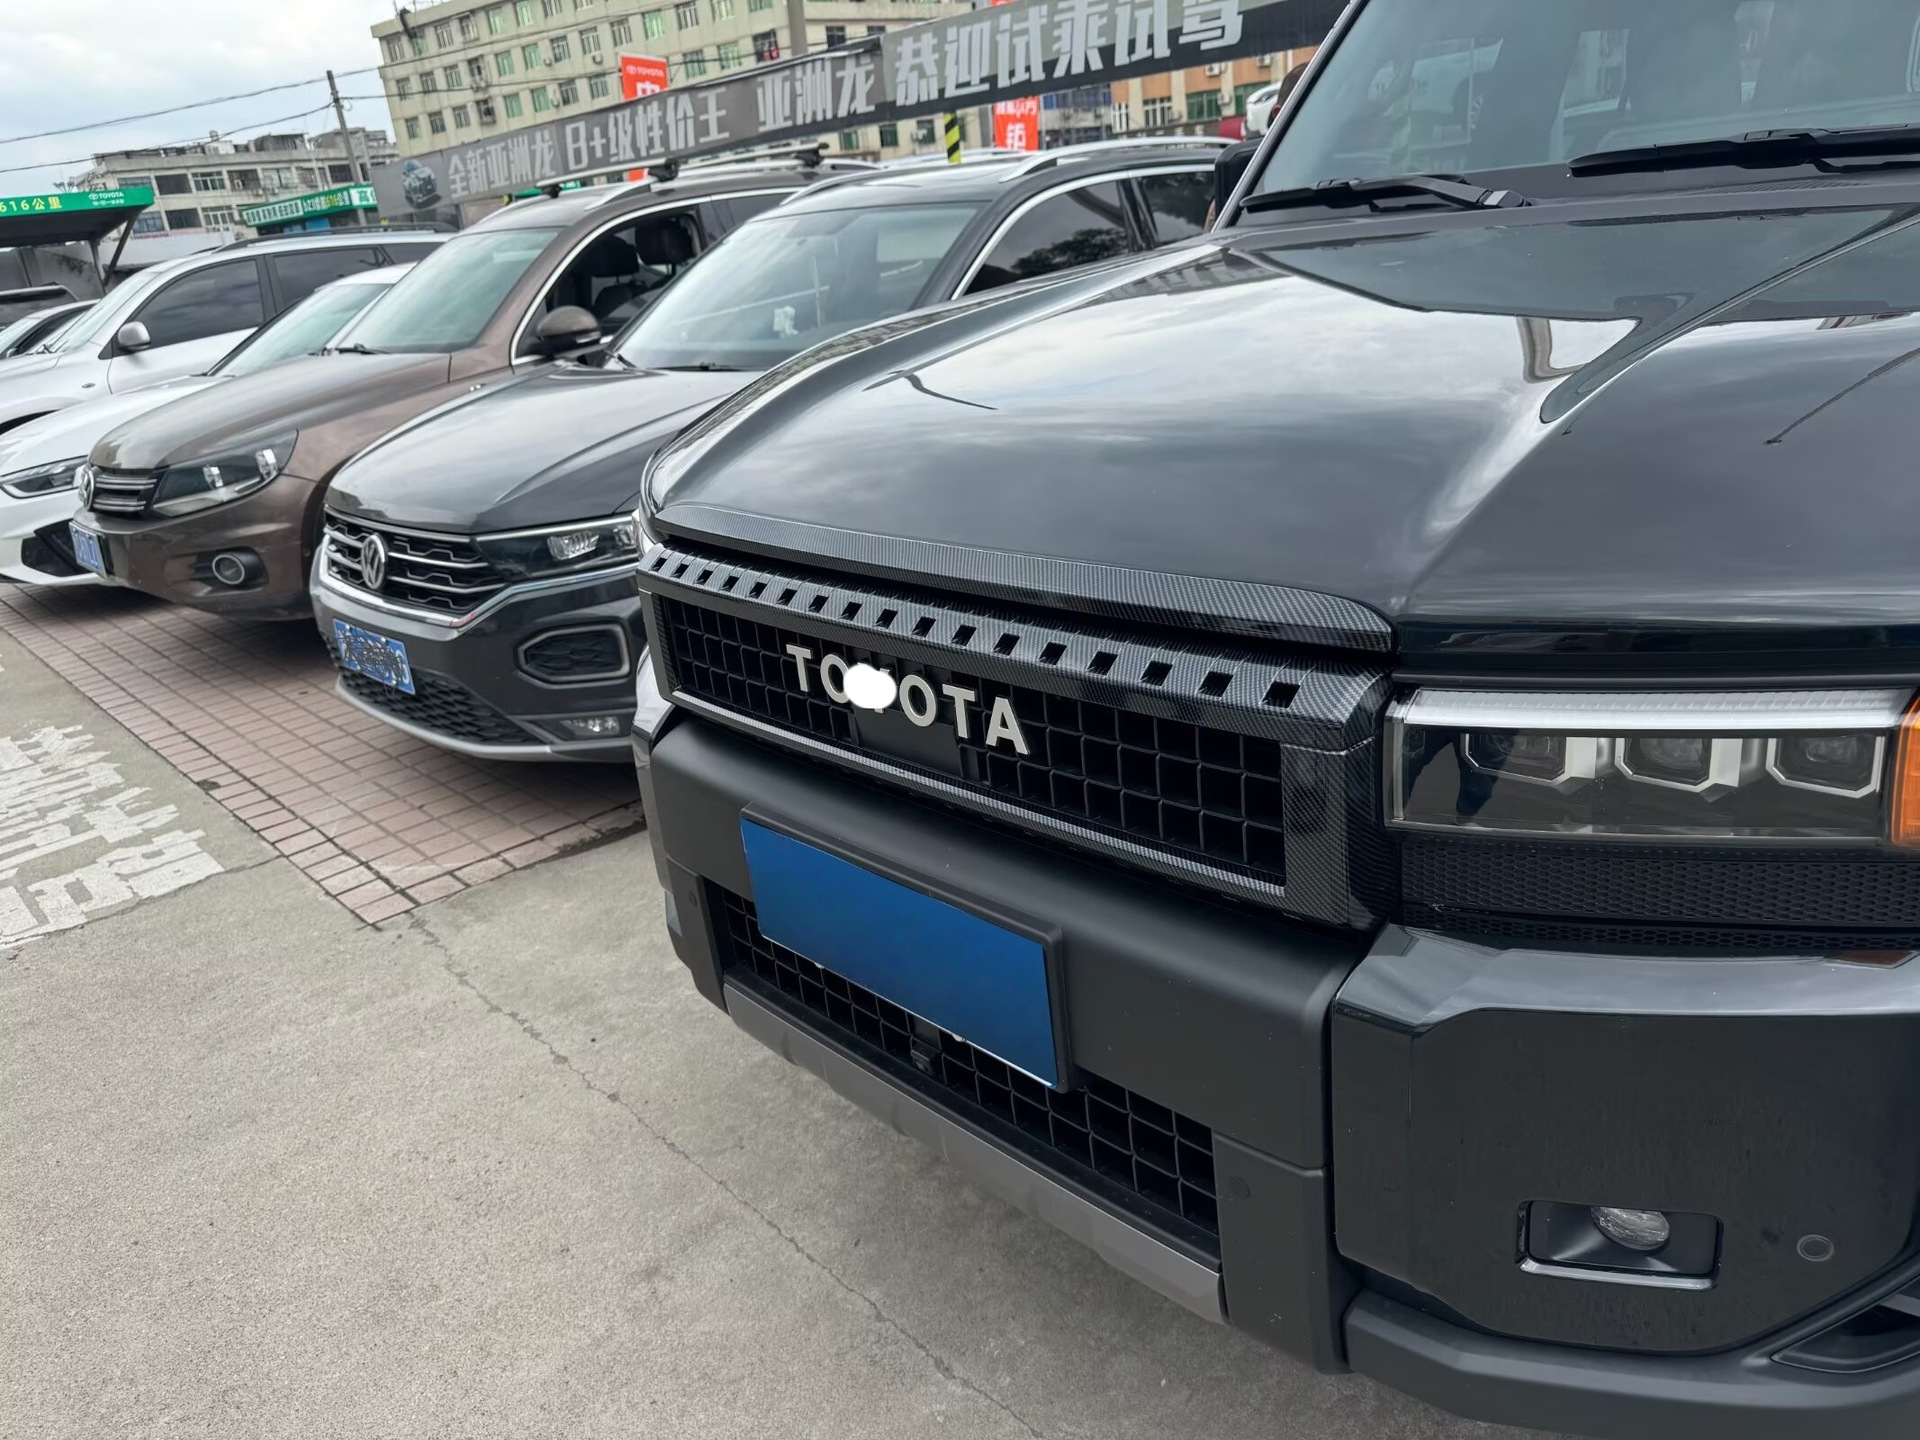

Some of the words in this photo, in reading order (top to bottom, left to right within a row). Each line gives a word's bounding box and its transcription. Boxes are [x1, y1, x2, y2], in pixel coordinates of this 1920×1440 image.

[448, 129, 556, 198] 全新亚洲龙
[565, 87, 730, 171] B+级性价王
[757, 54, 876, 132] 亚洲龙
[895, 0, 1243, 106] 恭迎试乘试驾
[0, 196, 62, 212] 616公里
[99, 191, 124, 199] TOYOTA
[786, 643, 1029, 755] TOOTA
